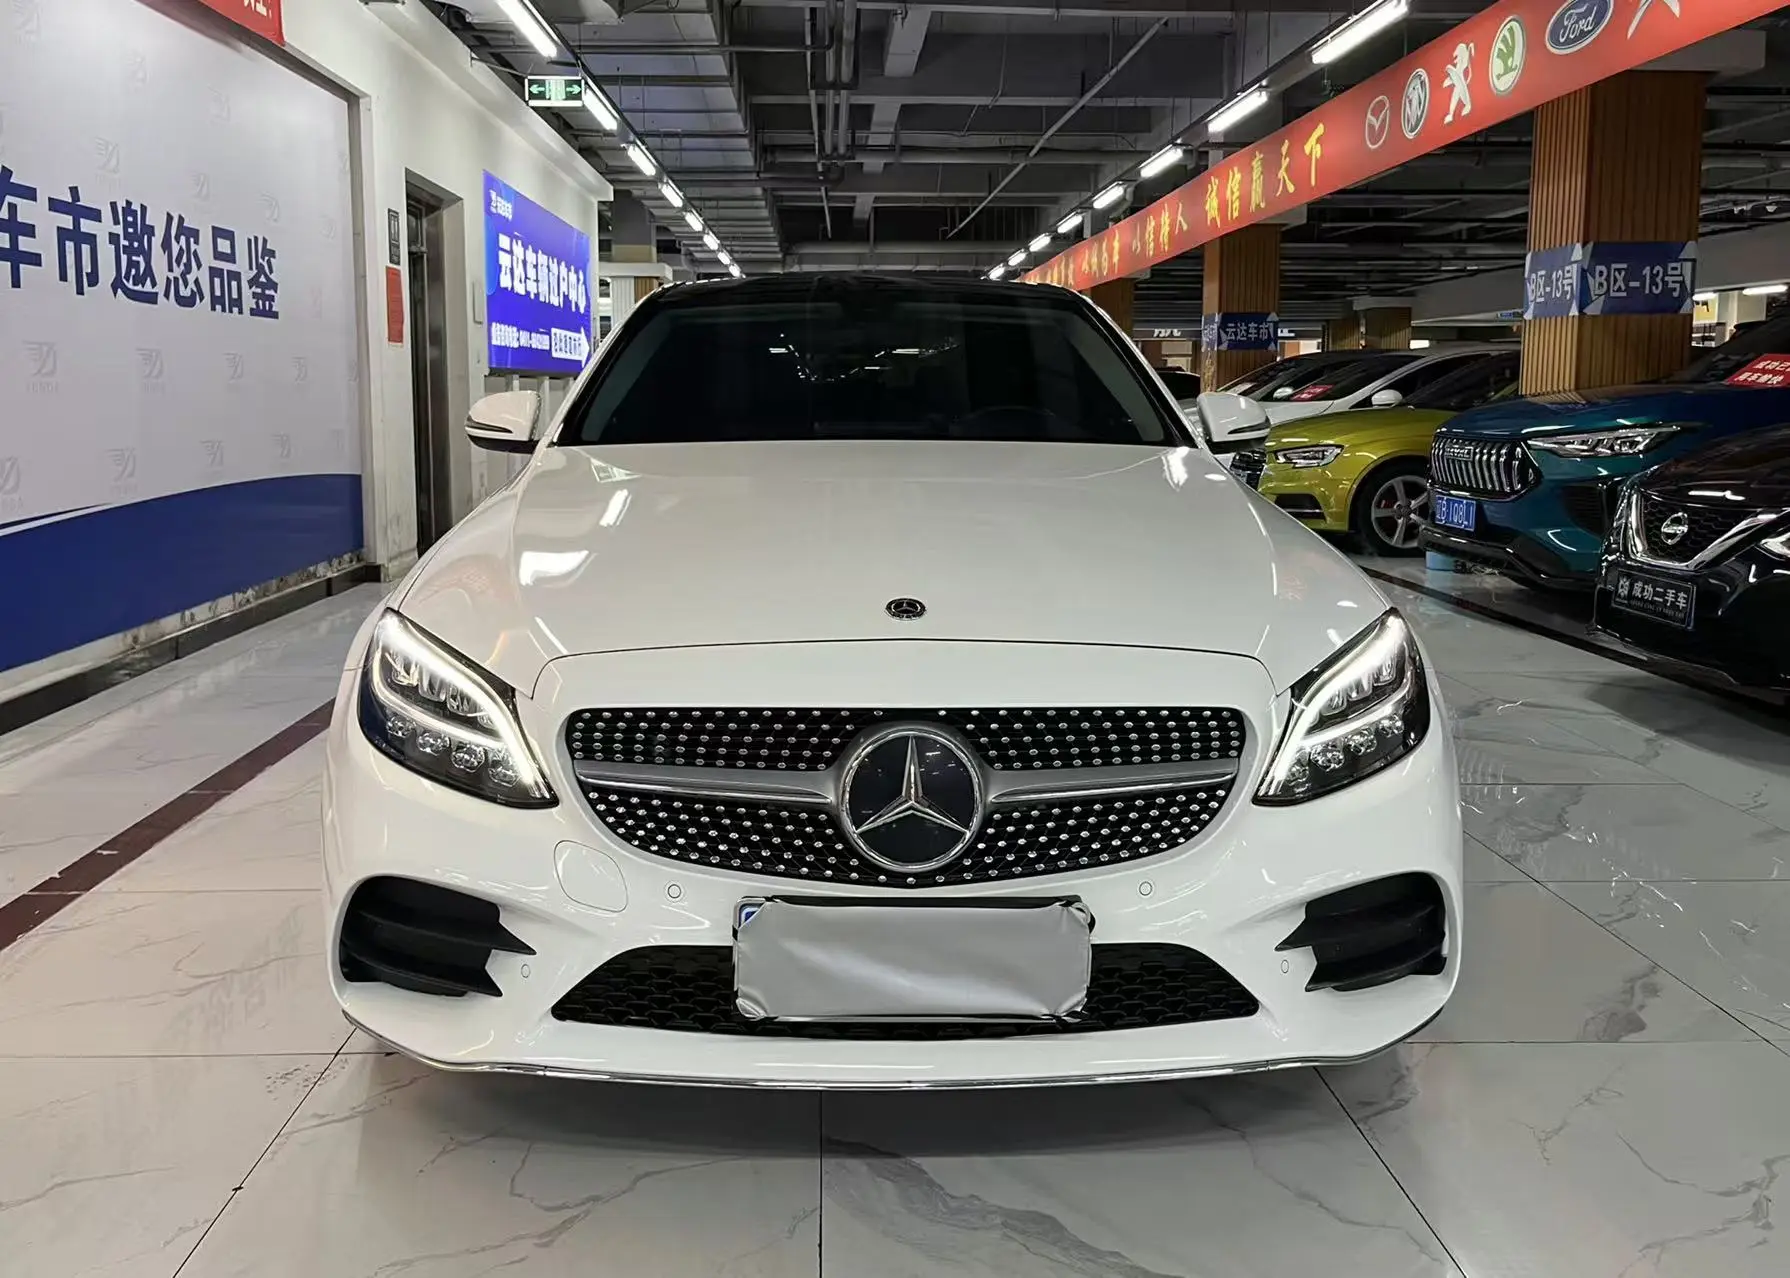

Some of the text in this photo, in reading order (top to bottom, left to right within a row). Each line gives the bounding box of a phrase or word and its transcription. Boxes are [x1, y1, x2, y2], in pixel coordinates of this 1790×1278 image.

[1560, 3, 1597, 42] Ford
[1205, 122, 1325, 228] 诚信赢天下
[0, 165, 279, 320] 车市邀您品鉴
[1530, 265, 1573, 302] B区-13号
[1594, 262, 1684, 298] B区-13号
[1226, 322, 1271, 341] 云达车市
[1632, 581, 1688, 610] 成功二手车
